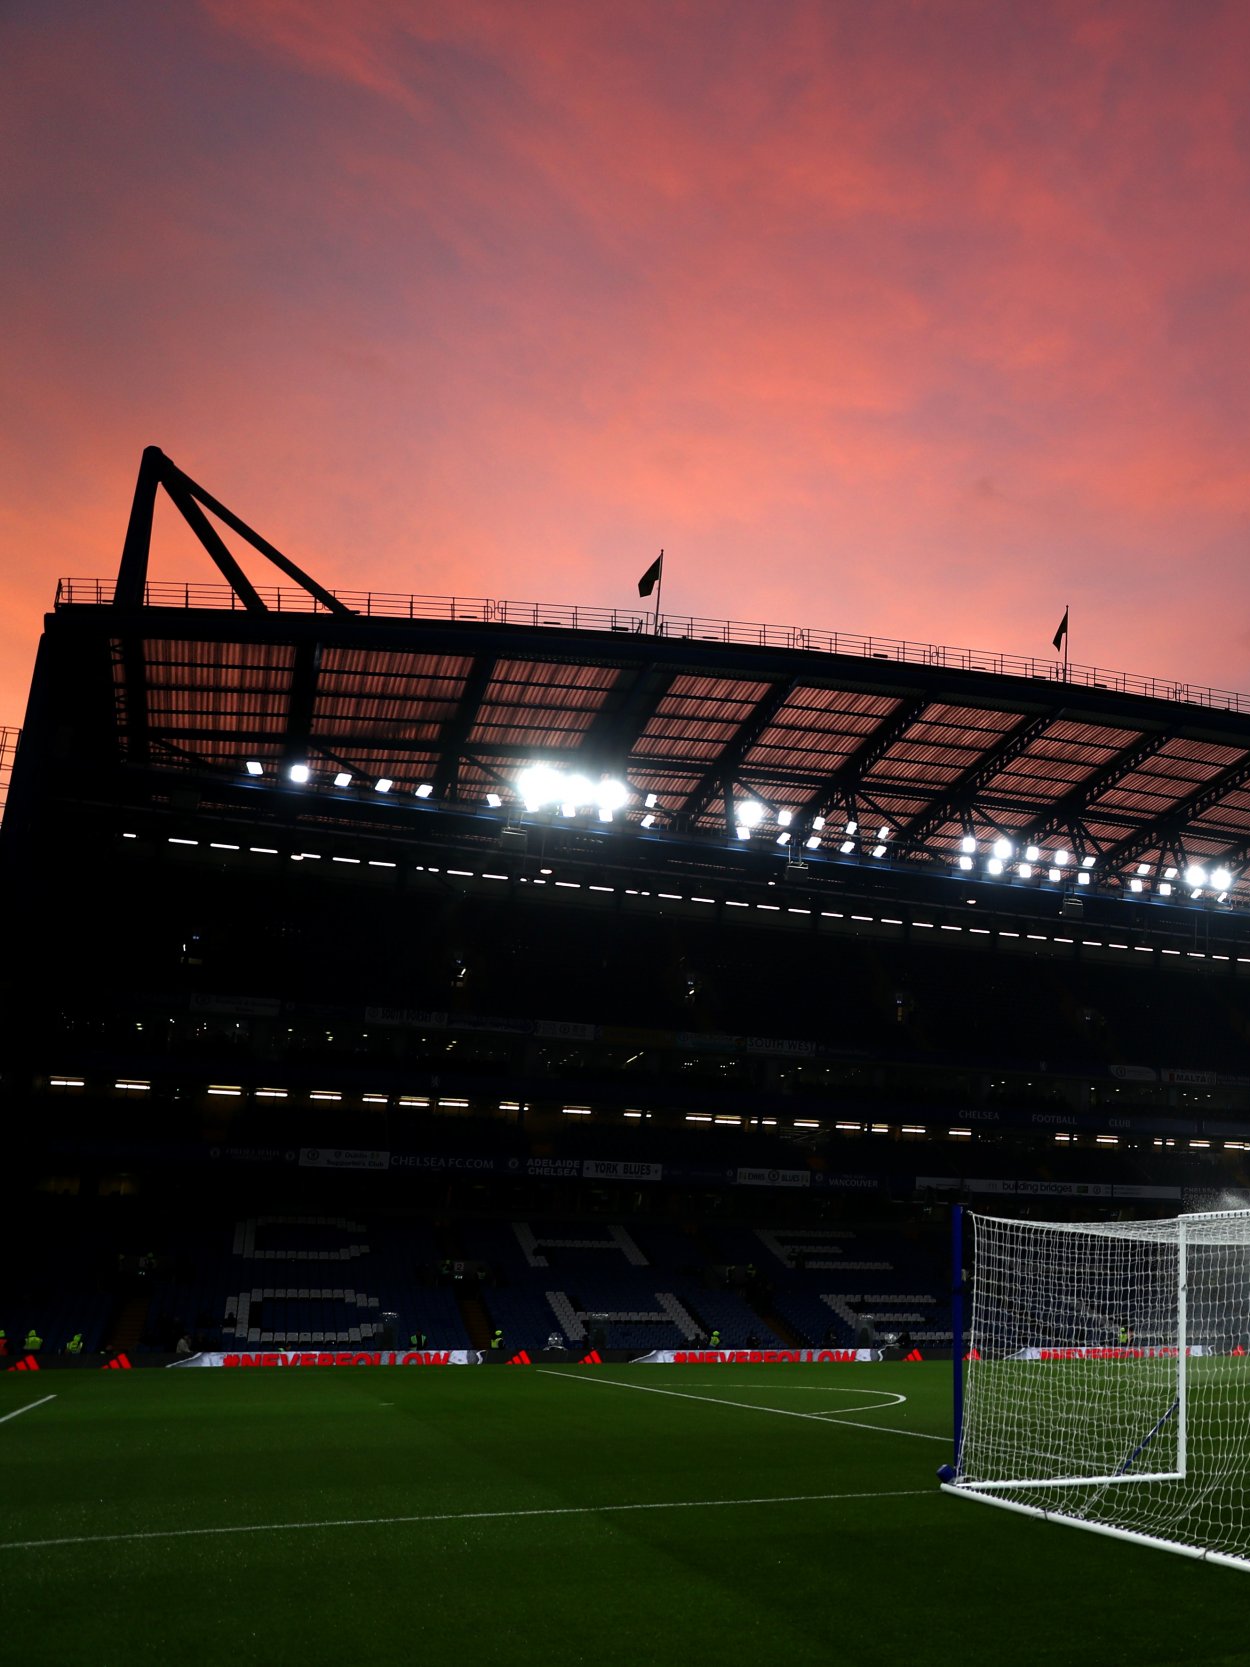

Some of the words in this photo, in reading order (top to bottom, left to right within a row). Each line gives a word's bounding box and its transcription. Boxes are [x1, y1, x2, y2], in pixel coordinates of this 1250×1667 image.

[747, 1038, 785, 1049] SOUTH
[787, 1040, 815, 1051] WEST
[1177, 1073, 1206, 1083] MALTA
[958, 1109, 1000, 1121] CHELSEA
[1031, 1113, 1078, 1126] FOOTBALL
[1108, 1118, 1131, 1128] CLUB
[526, 1158, 580, 1169] ADELAIDE
[594, 1162, 618, 1175] YORK
[623, 1163, 651, 1176] BLUES
[528, 1166, 578, 1176] CHELSEA
[828, 1177, 879, 1189] VANCOUVER
[1003, 1182, 1038, 1193] building
[1040, 1183, 1072, 1194] bridges
